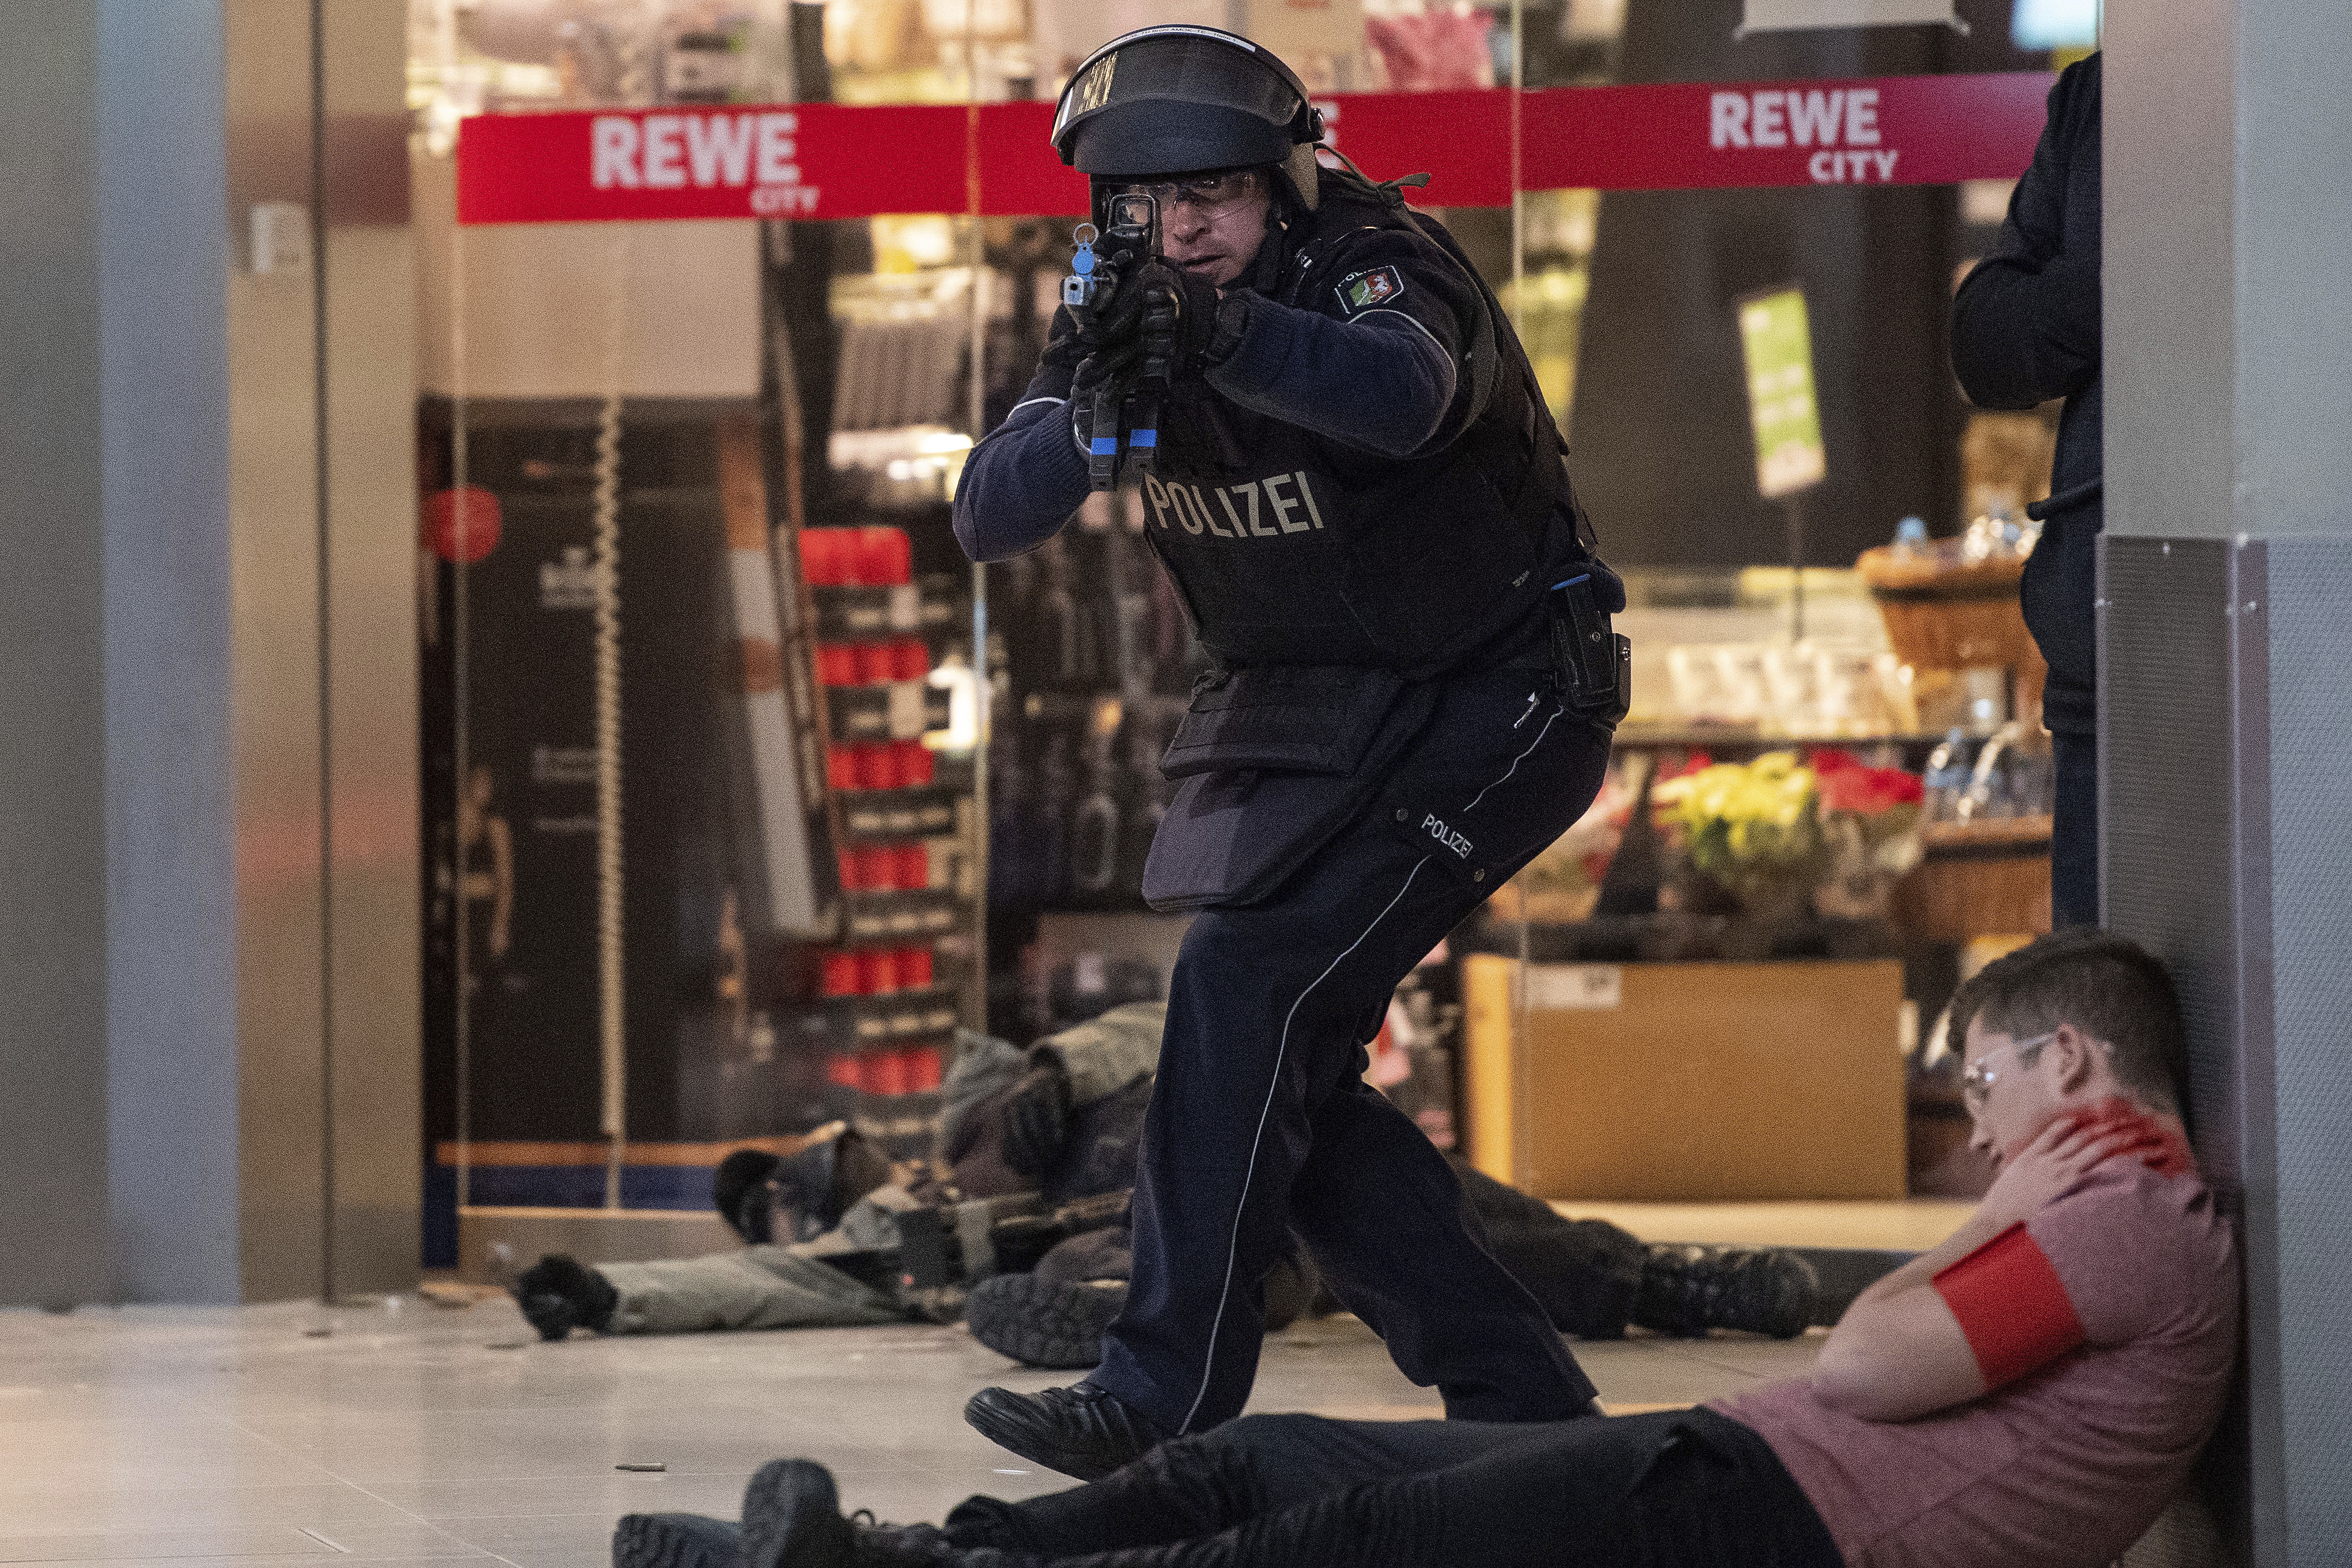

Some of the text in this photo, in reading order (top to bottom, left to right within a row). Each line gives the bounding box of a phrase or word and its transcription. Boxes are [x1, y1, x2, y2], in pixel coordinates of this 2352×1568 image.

[1711, 89, 1881, 149] REWE
[592, 113, 801, 188] REWE
[1810, 149, 1899, 182] CITY
[1145, 471, 1324, 538] POLIZEI
[1420, 813, 1473, 859] POLIZEI
